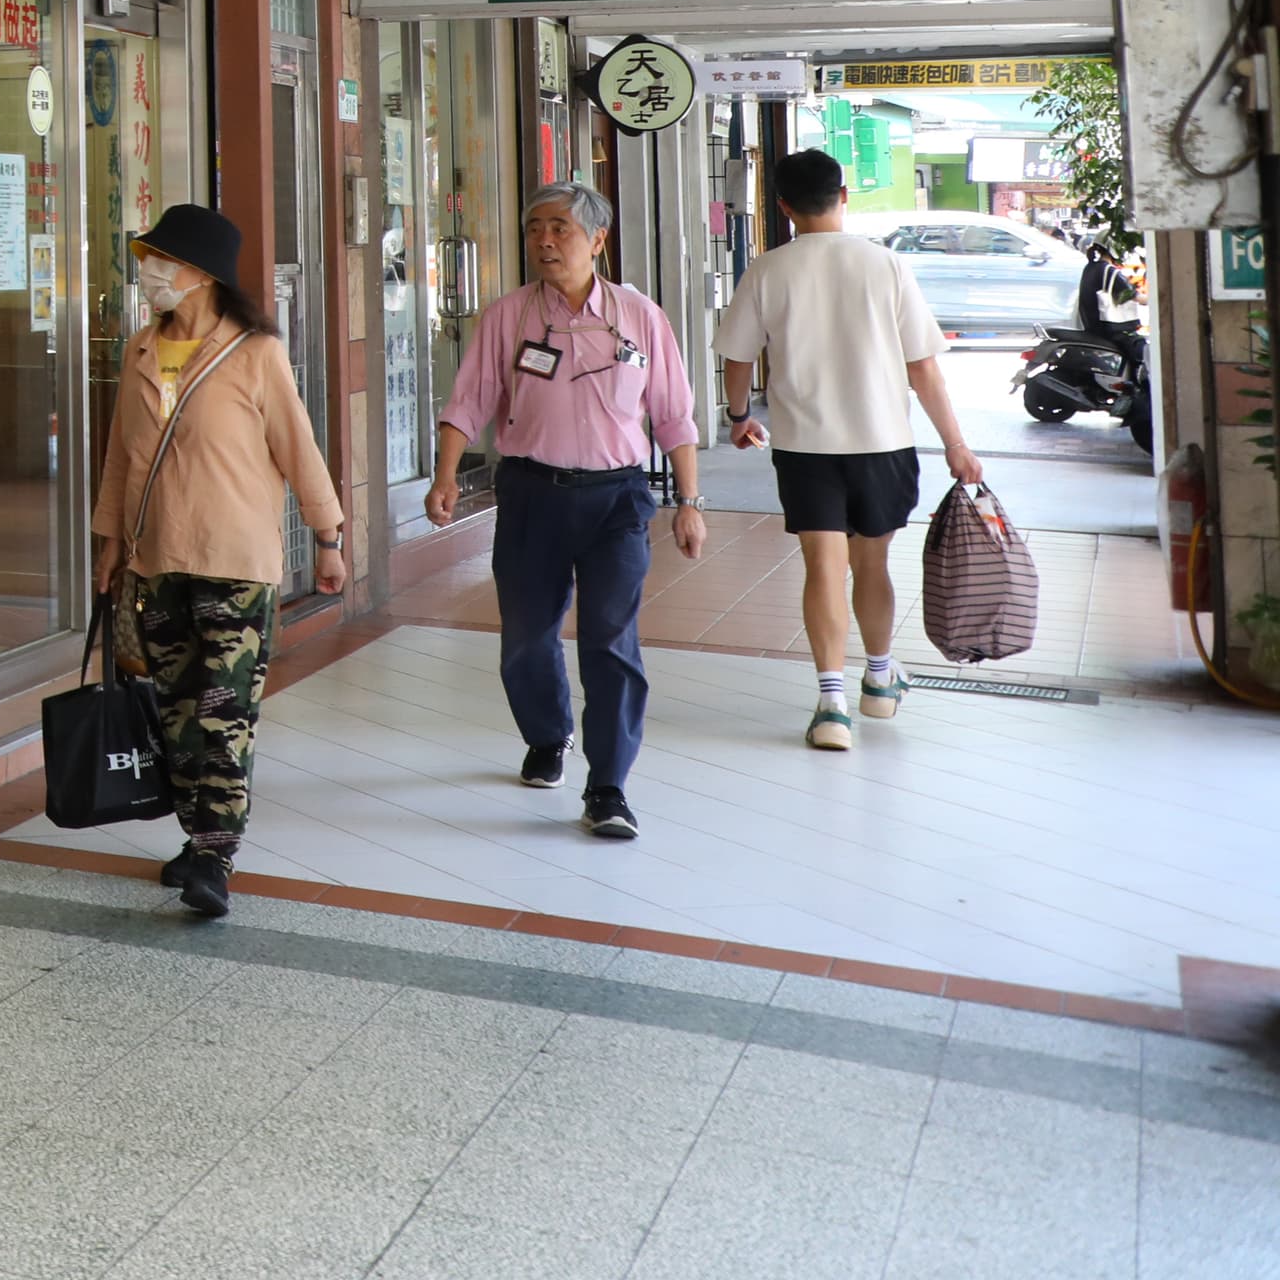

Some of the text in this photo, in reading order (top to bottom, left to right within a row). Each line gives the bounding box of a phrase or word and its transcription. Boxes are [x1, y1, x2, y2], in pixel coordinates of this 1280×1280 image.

[615, 49, 675, 124] 天乙居士
[844, 63, 975, 86] 電腦快速彩色印刷
[979, 62, 1011, 83] 名片
[1014, 62, 1047, 82] 喜帖
